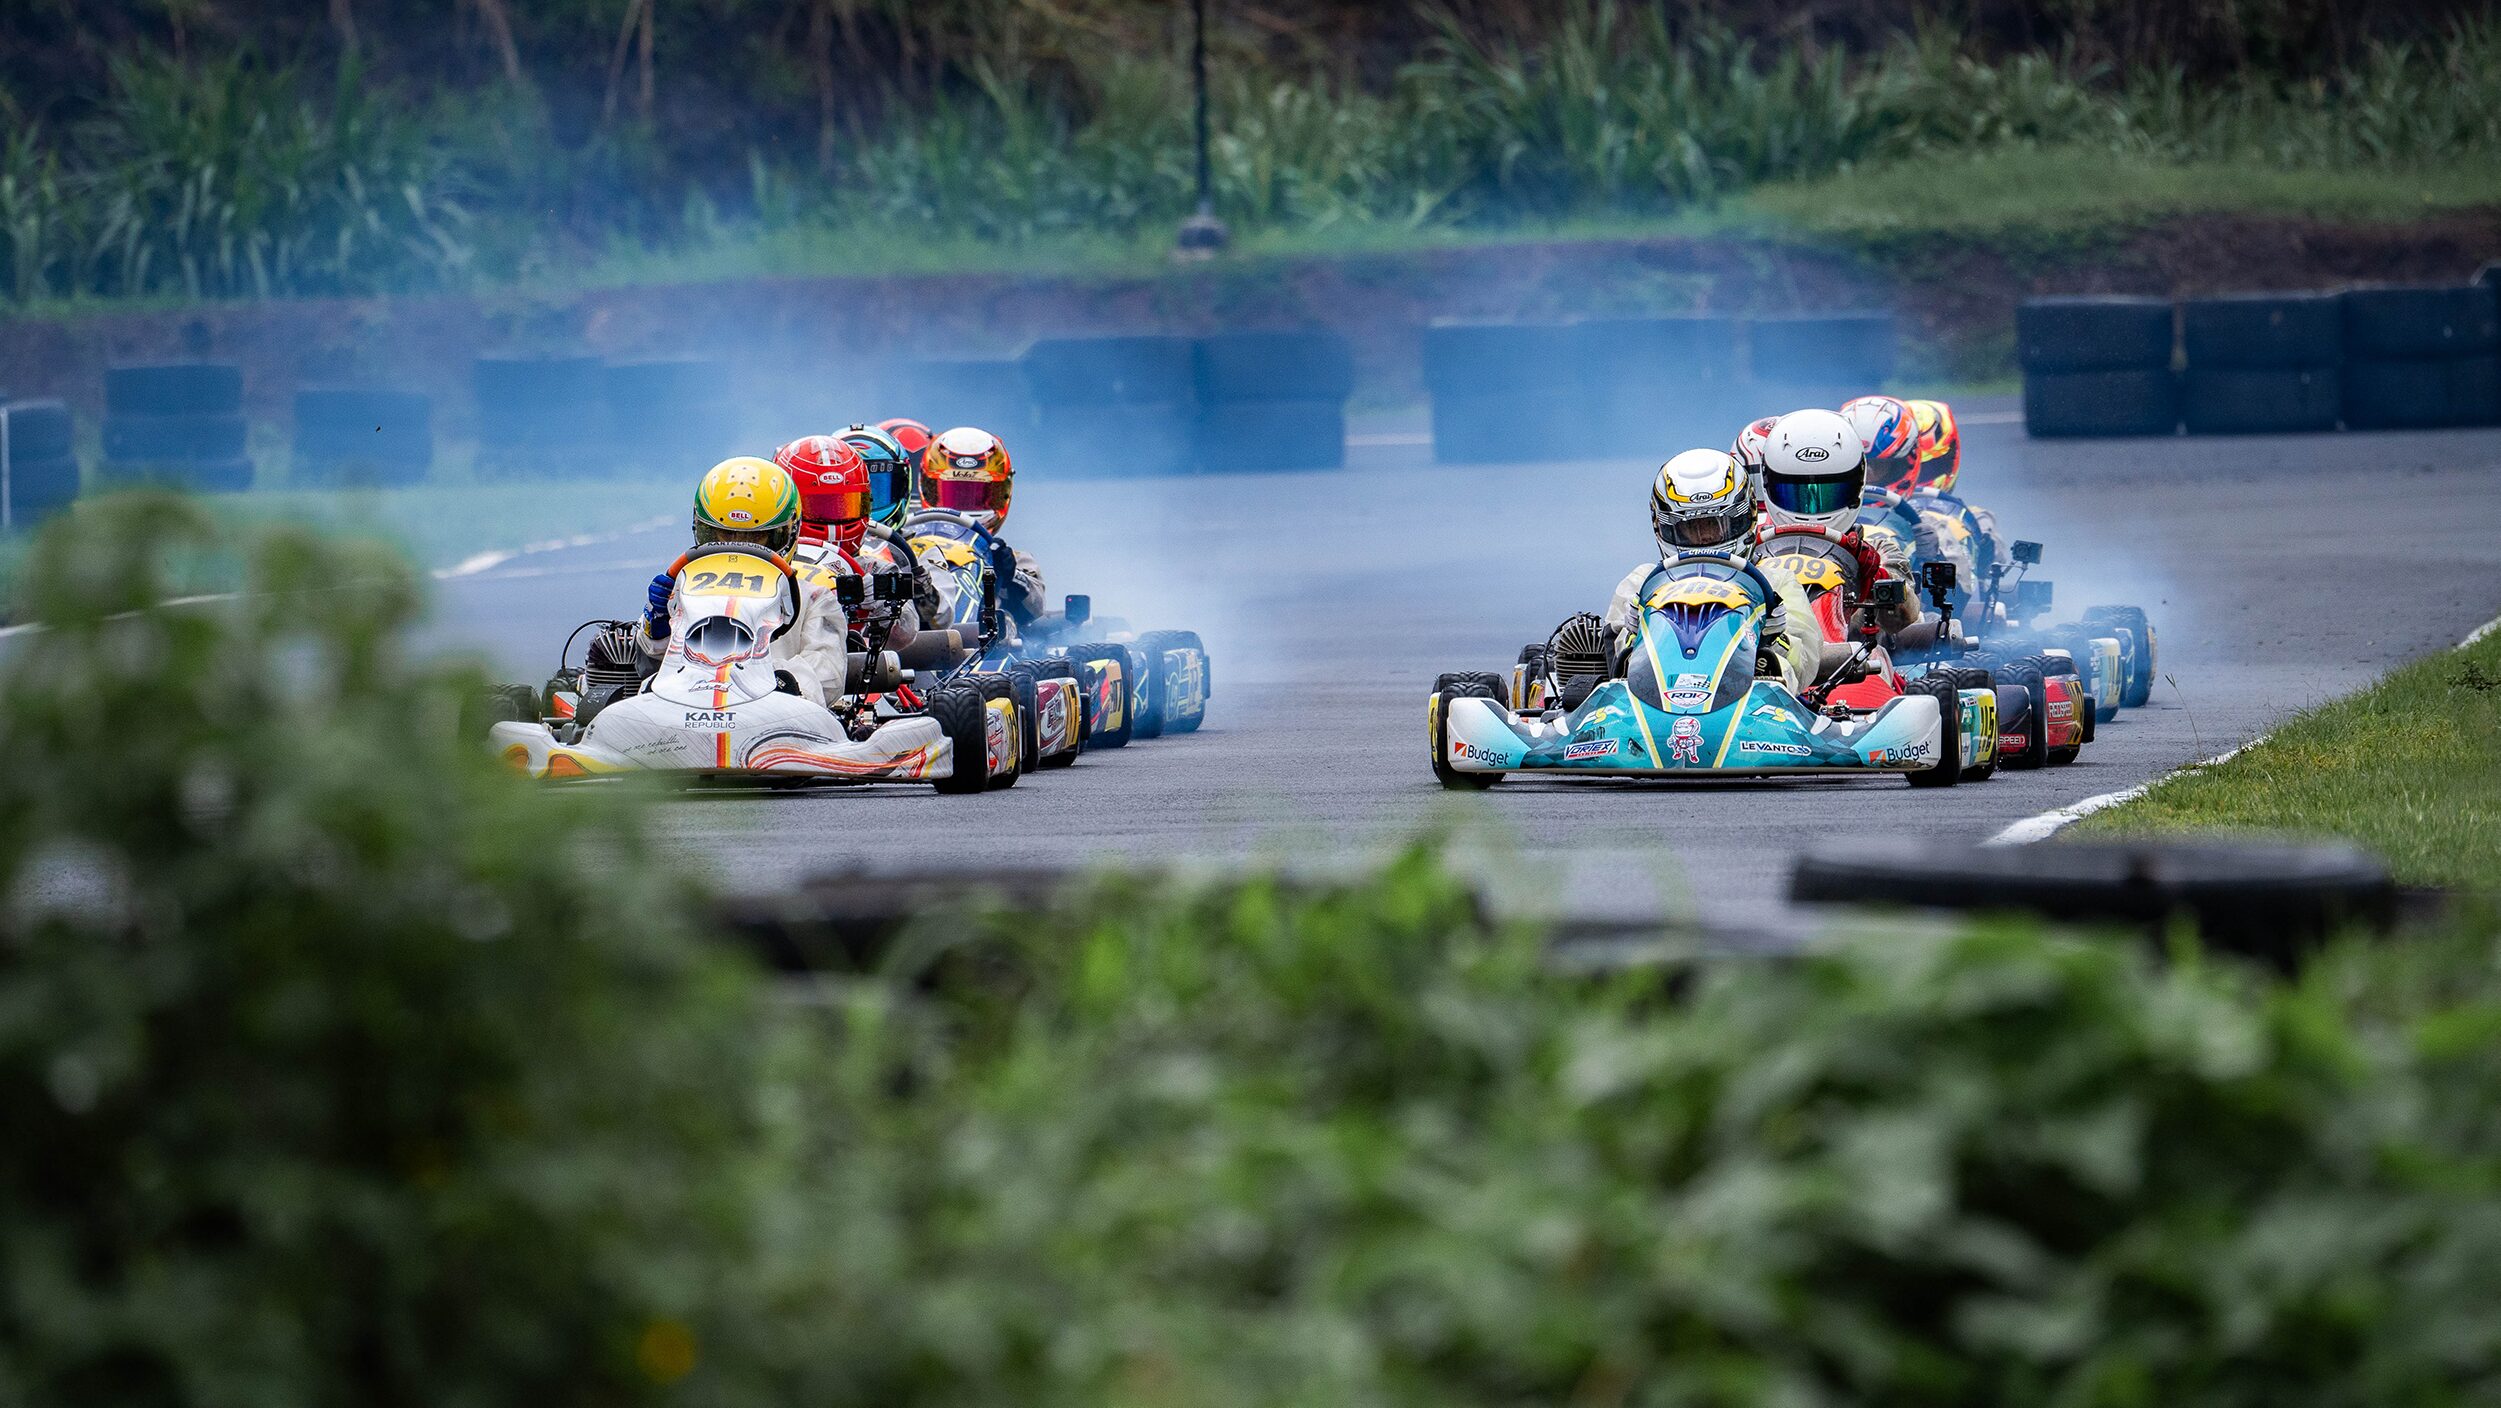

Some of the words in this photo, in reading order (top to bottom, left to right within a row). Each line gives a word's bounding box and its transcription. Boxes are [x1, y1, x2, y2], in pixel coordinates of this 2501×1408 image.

[1799, 448, 1825, 458] Arai
[1693, 492, 1710, 500] Arai
[690, 572, 764, 592] 241
[685, 712, 737, 721] KART
[685, 721, 736, 729] REPUBLIC
[1566, 741, 1612, 756] VORTEX
[1887, 741, 1931, 763] Budget
[1467, 744, 1509, 767] Budget
